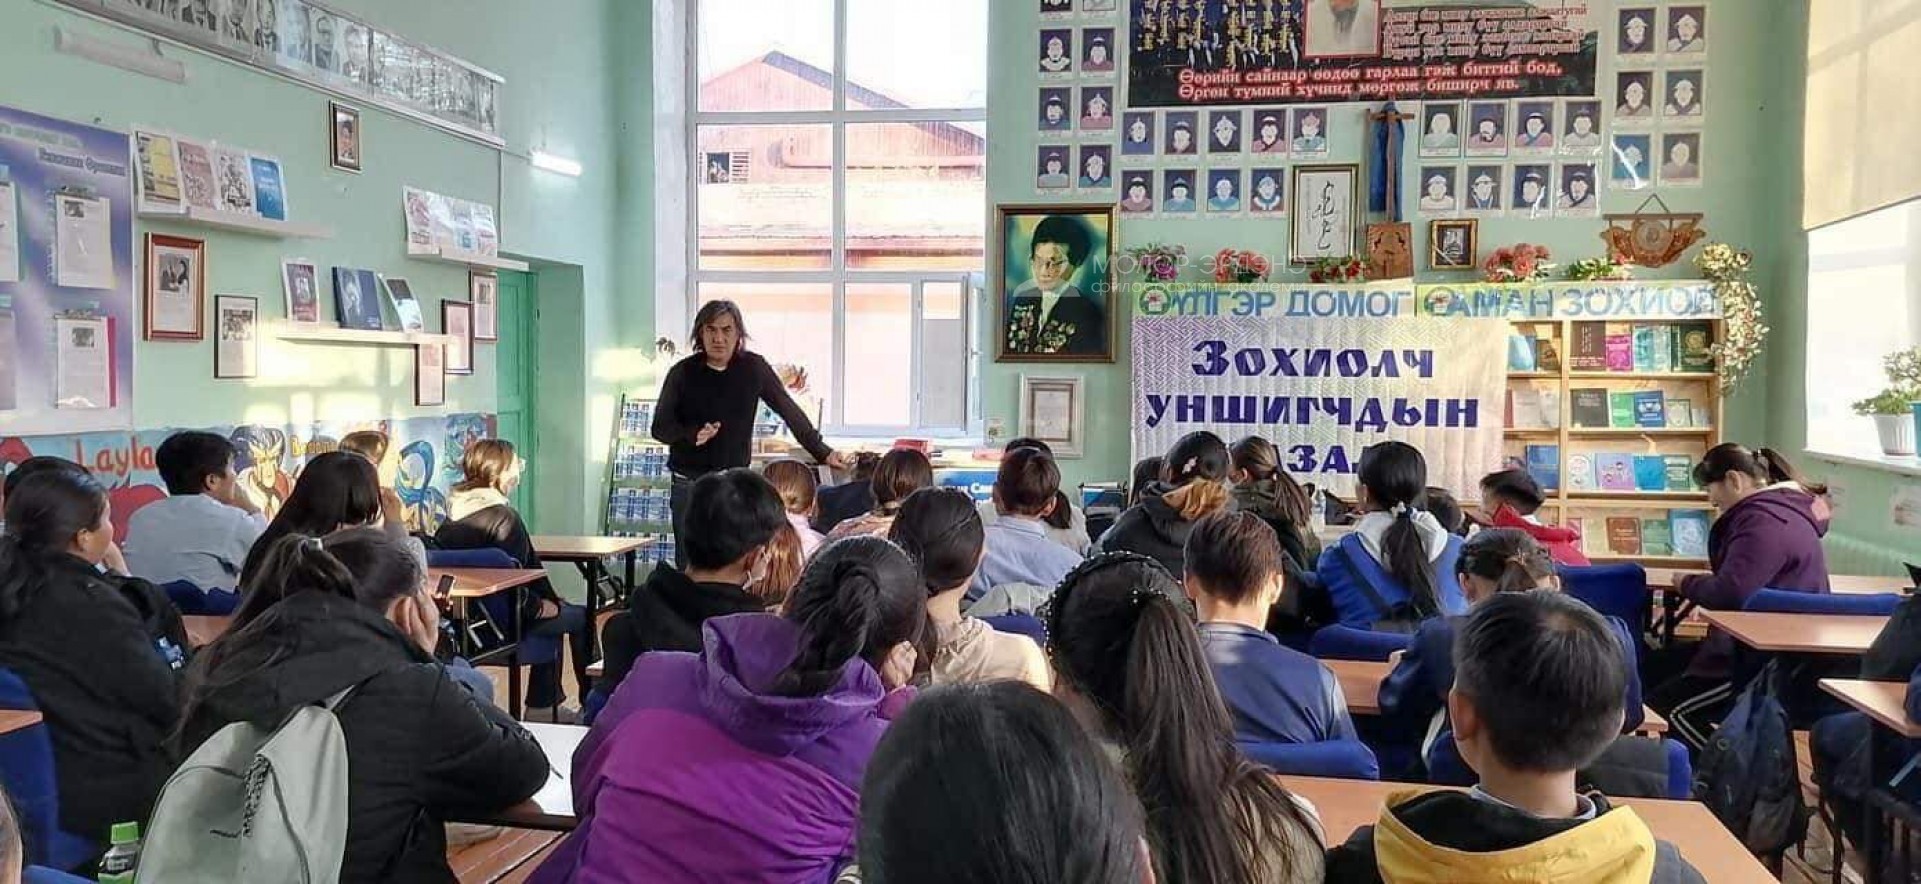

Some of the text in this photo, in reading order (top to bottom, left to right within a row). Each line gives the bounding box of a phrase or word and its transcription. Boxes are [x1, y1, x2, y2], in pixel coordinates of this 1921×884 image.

[1178, 60, 1563, 85] Өөрийн сайнаар өөдөө гарлаа гэж битгий бод,
[1178, 84, 1229, 100] Өргөн
[1234, 83, 1291, 99] түмний
[1295, 84, 1352, 100] хүчинд
[1359, 80, 1420, 97] мөргөж
[1426, 77, 1490, 94] биширч
[1285, 290, 1411, 317] ДОМОГ
[1191, 340, 1434, 378] Зохиолч
[1145, 394, 1479, 433] уншигчдын
[75, 436, 156, 477] Layla
